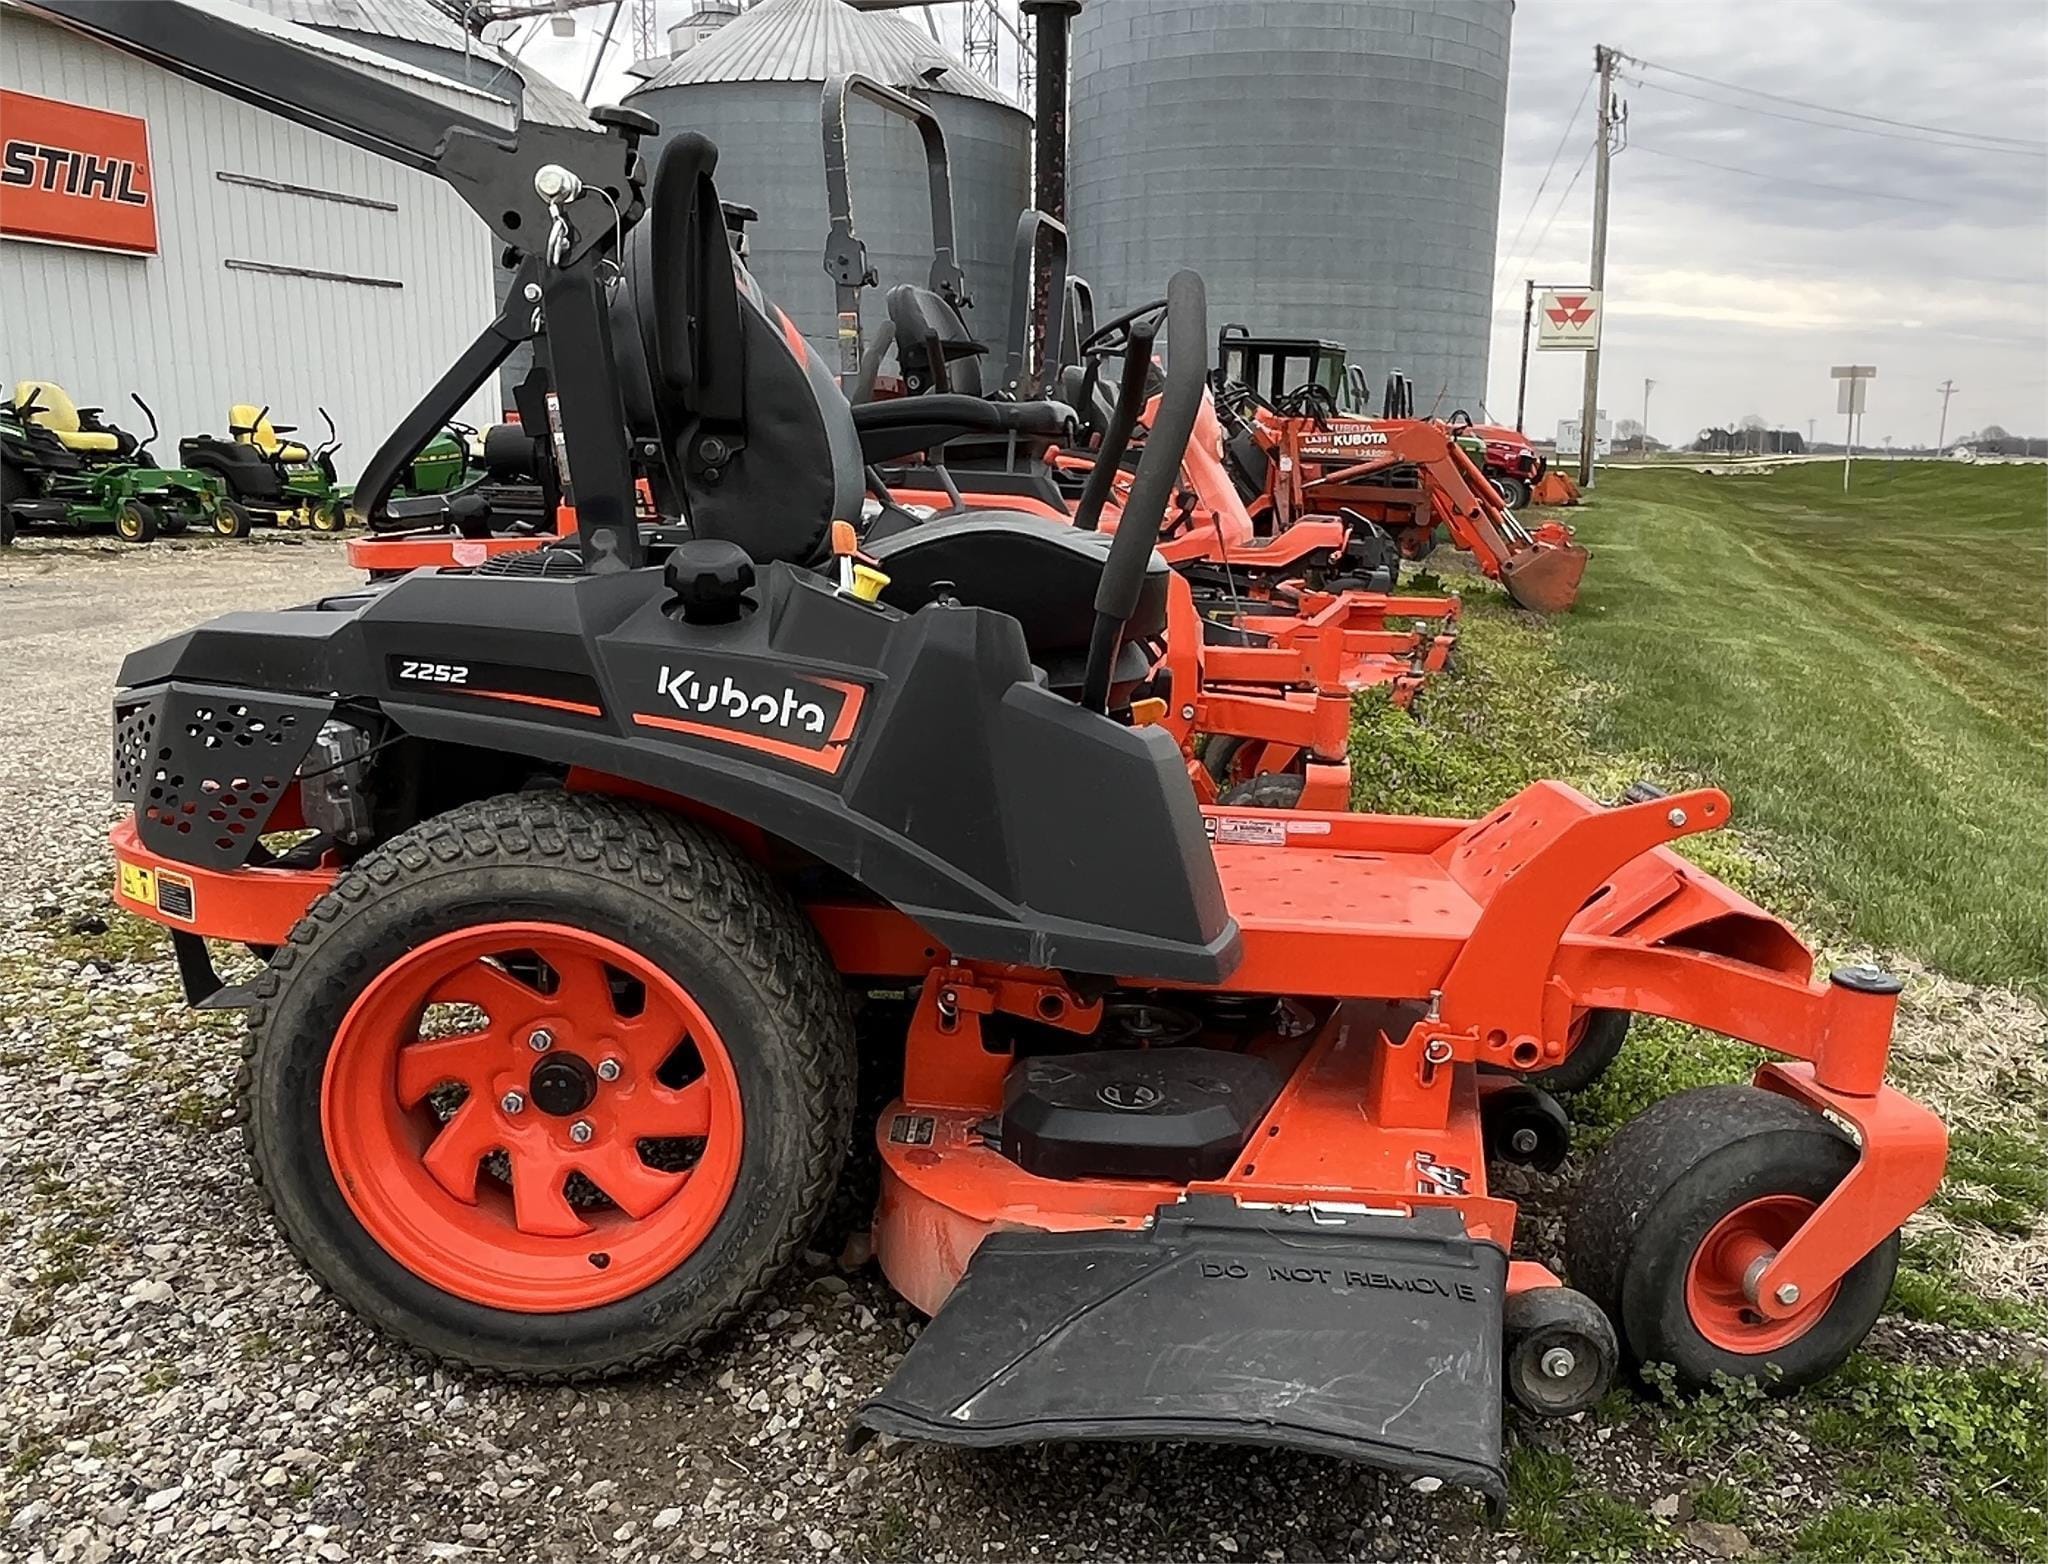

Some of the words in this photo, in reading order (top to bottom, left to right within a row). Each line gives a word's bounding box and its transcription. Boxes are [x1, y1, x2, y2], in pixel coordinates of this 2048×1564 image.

[0, 139, 148, 207] STIHL
[1333, 432, 1388, 446] KUBOTA
[400, 661, 469, 684] Z252
[657, 665, 825, 733] Kubota
[1201, 1262, 1249, 1279] DO
[1267, 1264, 1332, 1284] NOT
[1343, 1268, 1478, 1302] REMOVE
